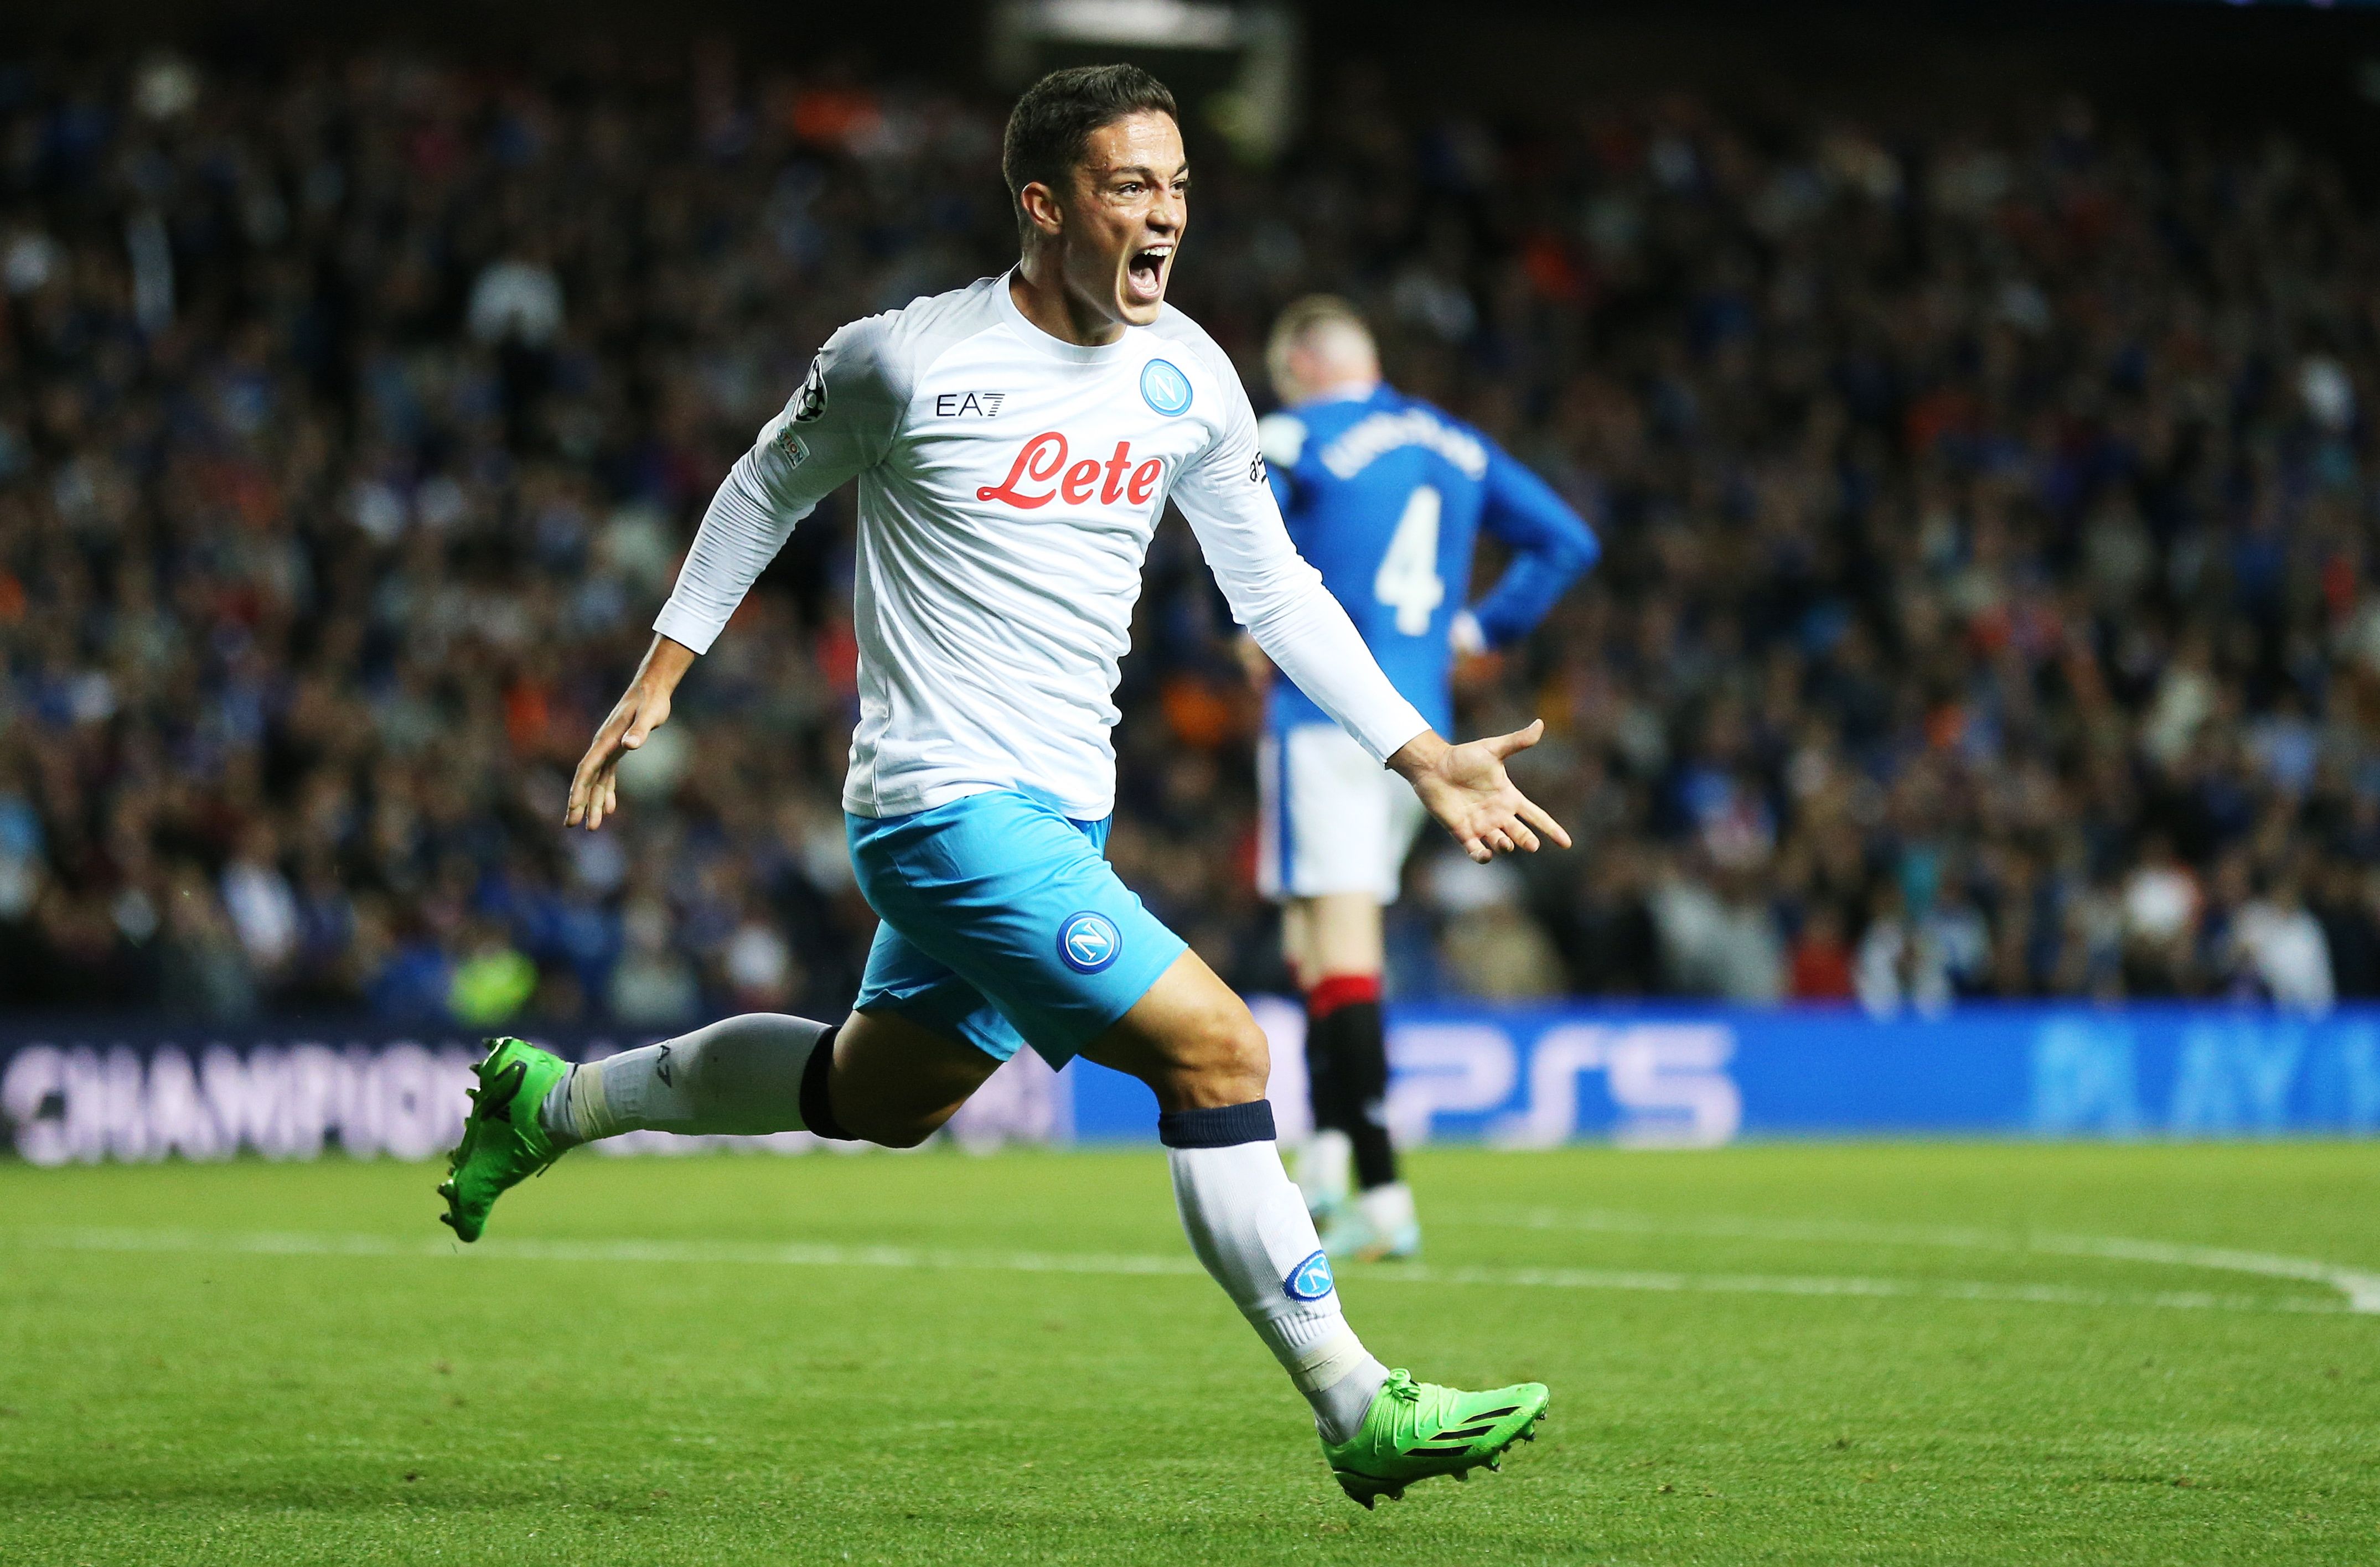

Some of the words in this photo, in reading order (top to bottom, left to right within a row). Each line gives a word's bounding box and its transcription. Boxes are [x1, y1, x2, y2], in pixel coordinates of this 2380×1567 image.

[937, 393, 1005, 416] EA7
[1152, 374, 1177, 403] N
[976, 432, 1161, 509] Lete
[1375, 485, 1445, 636] 4
[1070, 922, 1108, 961] N
[3, 1041, 480, 1161] CHAMPION
[1305, 1260, 1329, 1292] N
